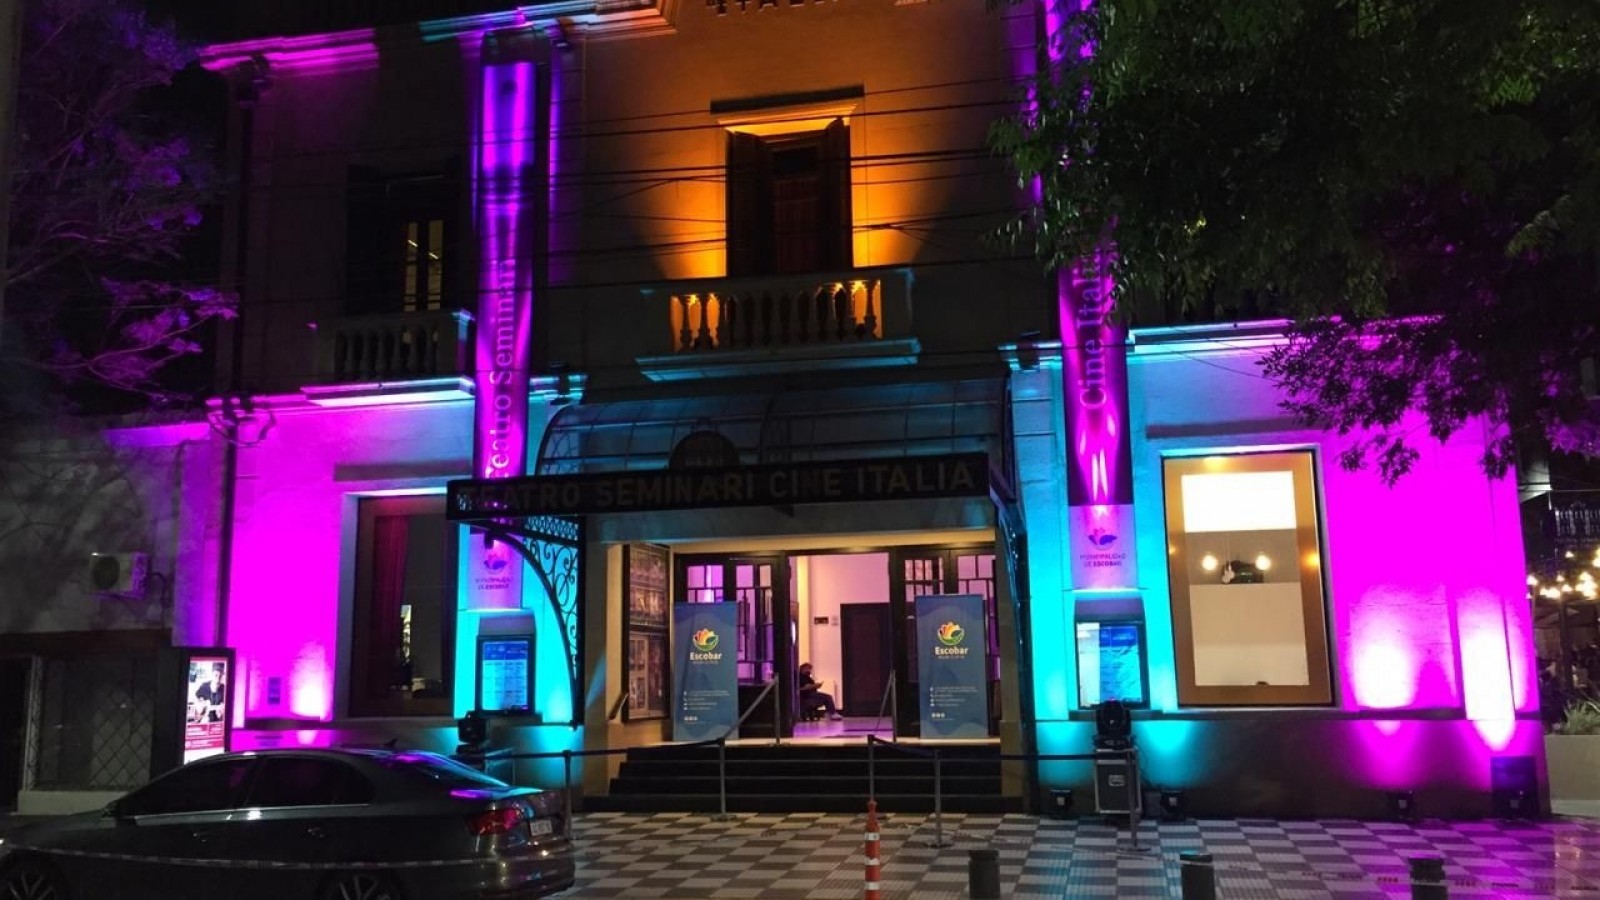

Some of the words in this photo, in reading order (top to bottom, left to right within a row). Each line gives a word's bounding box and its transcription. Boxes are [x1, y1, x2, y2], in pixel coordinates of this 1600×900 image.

[489, 259, 516, 384] Seminari
[1077, 340, 1107, 409] Cine
[460, 481, 582, 512] TEATRO
[596, 471, 754, 506] SEMINARI
[770, 467, 840, 499] CINE
[857, 462, 975, 494] ITALIA
[689, 651, 722, 661] Escobar
[935, 646, 969, 656] Escobar
